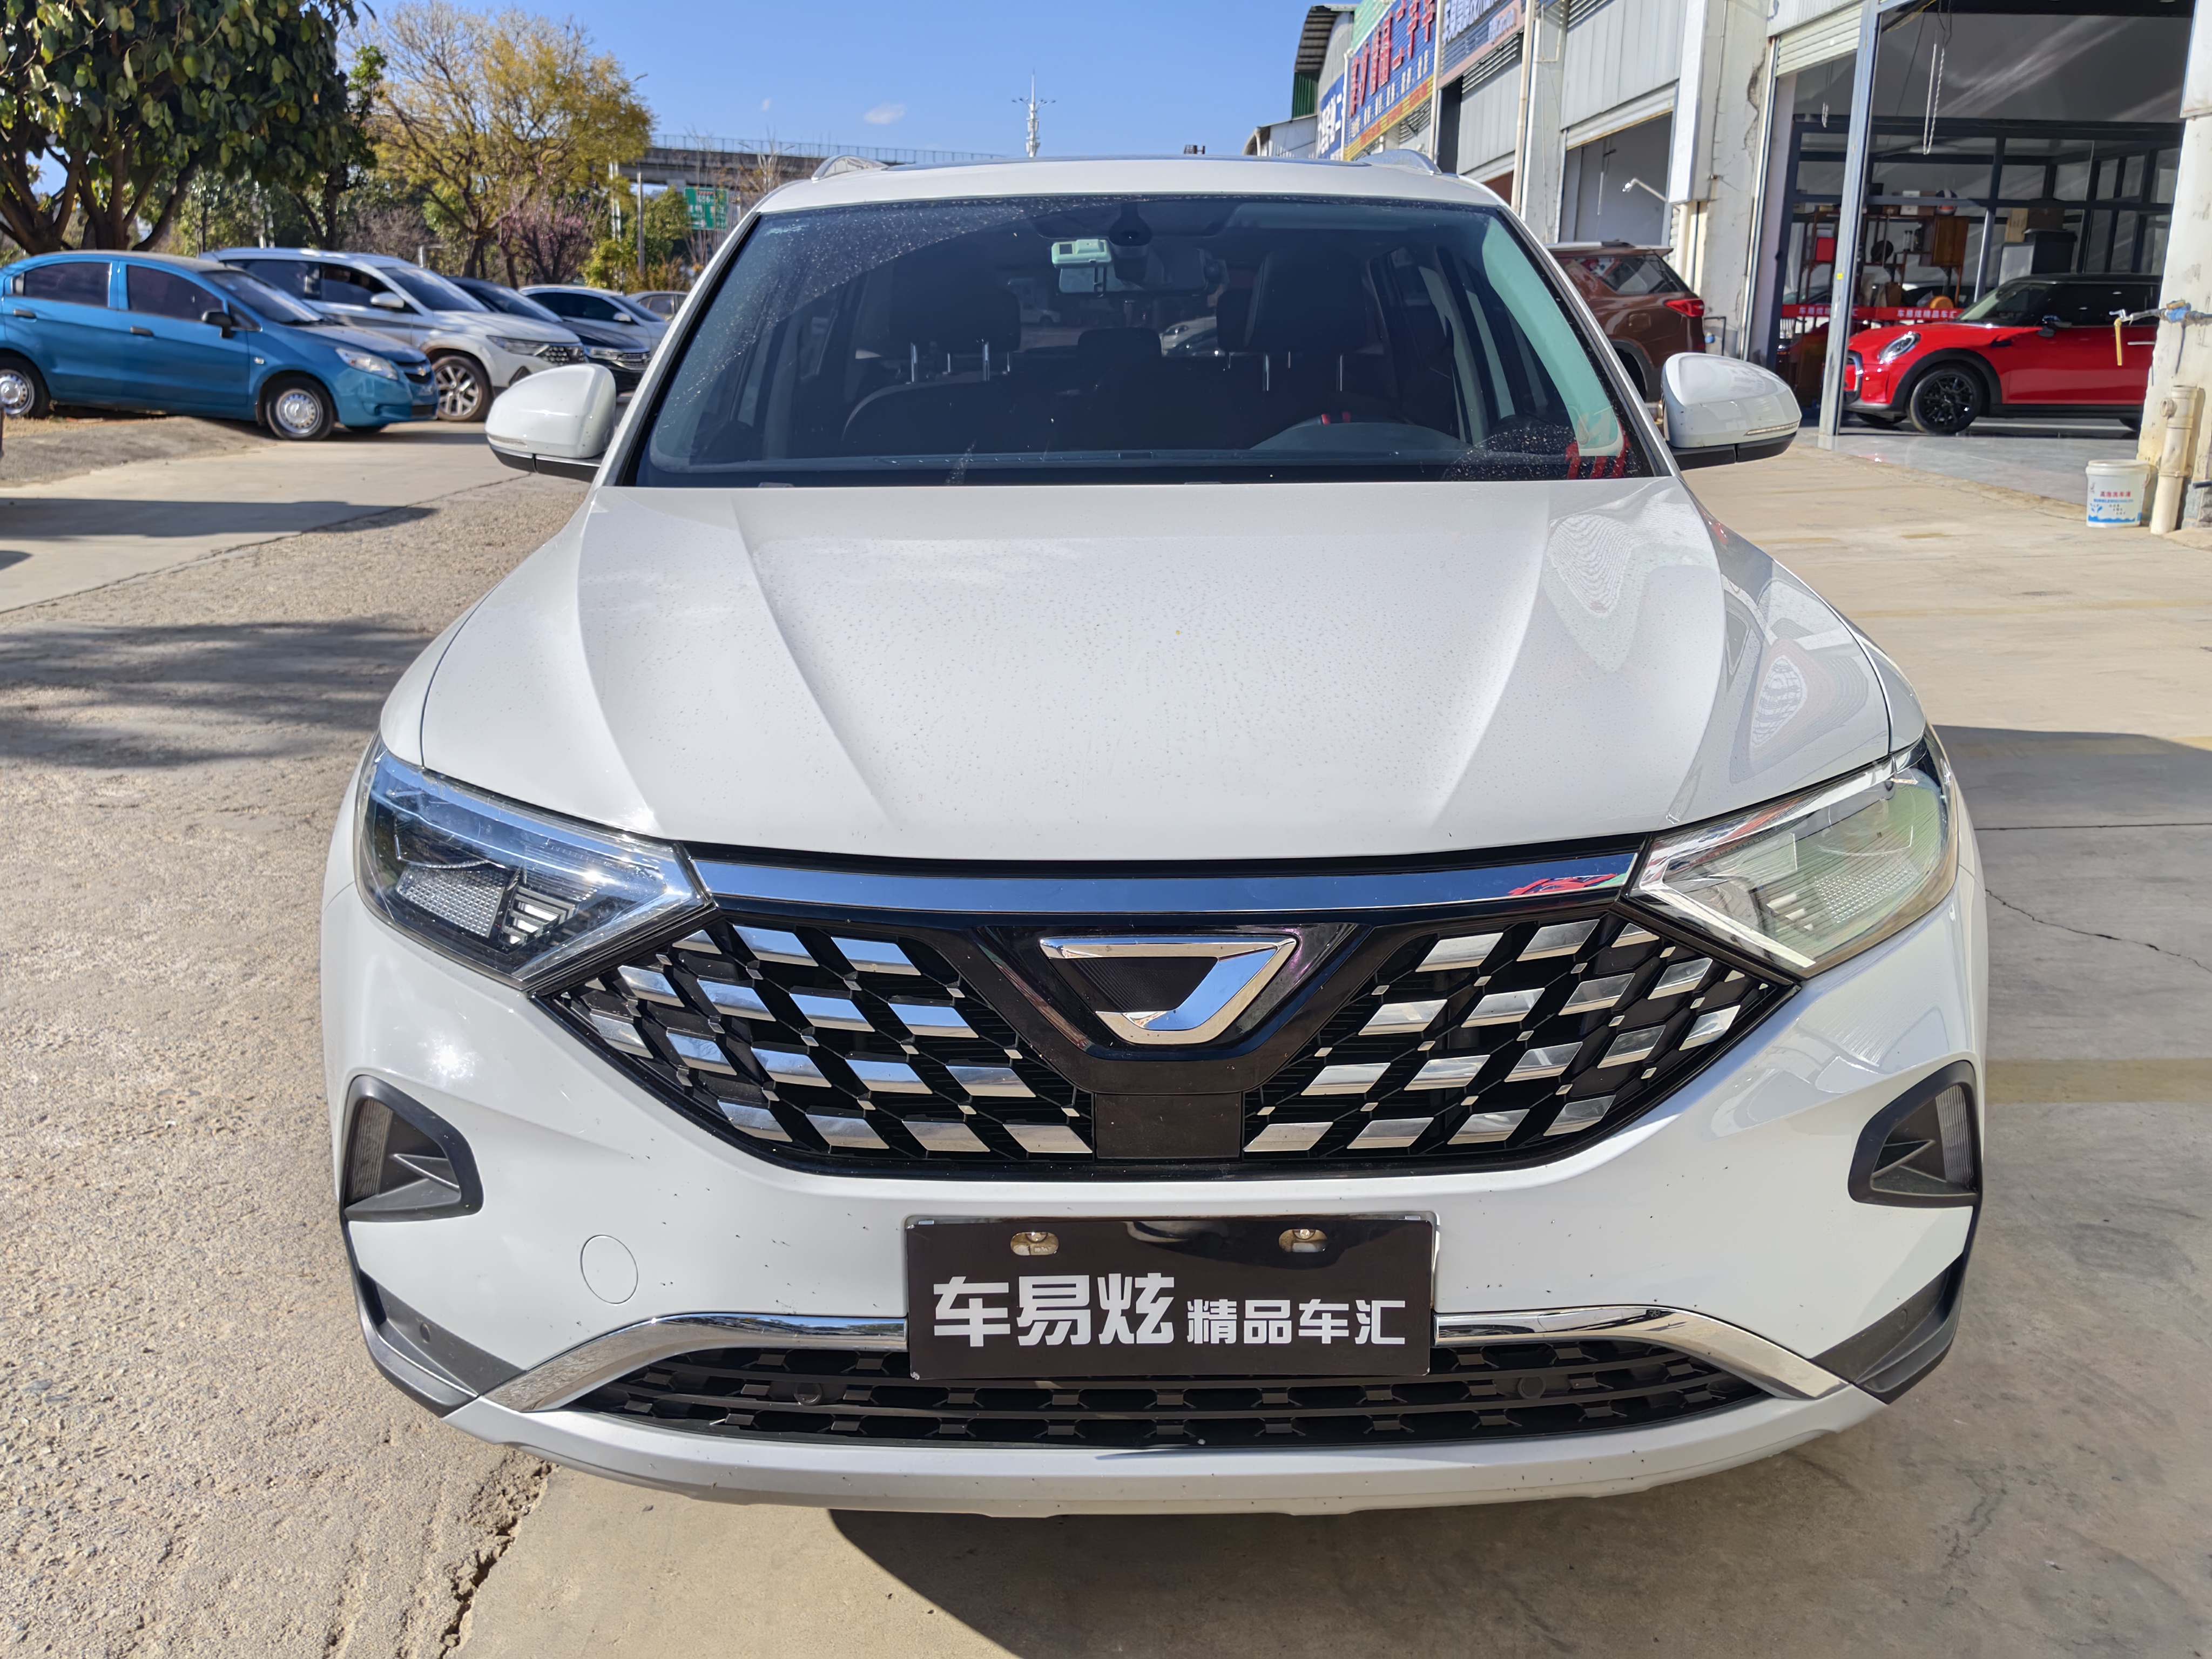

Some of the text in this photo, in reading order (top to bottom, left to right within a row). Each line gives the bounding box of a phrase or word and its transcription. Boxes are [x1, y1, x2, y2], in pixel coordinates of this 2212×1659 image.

[933, 1273, 1406, 1347] 车易炫 精品车汇
